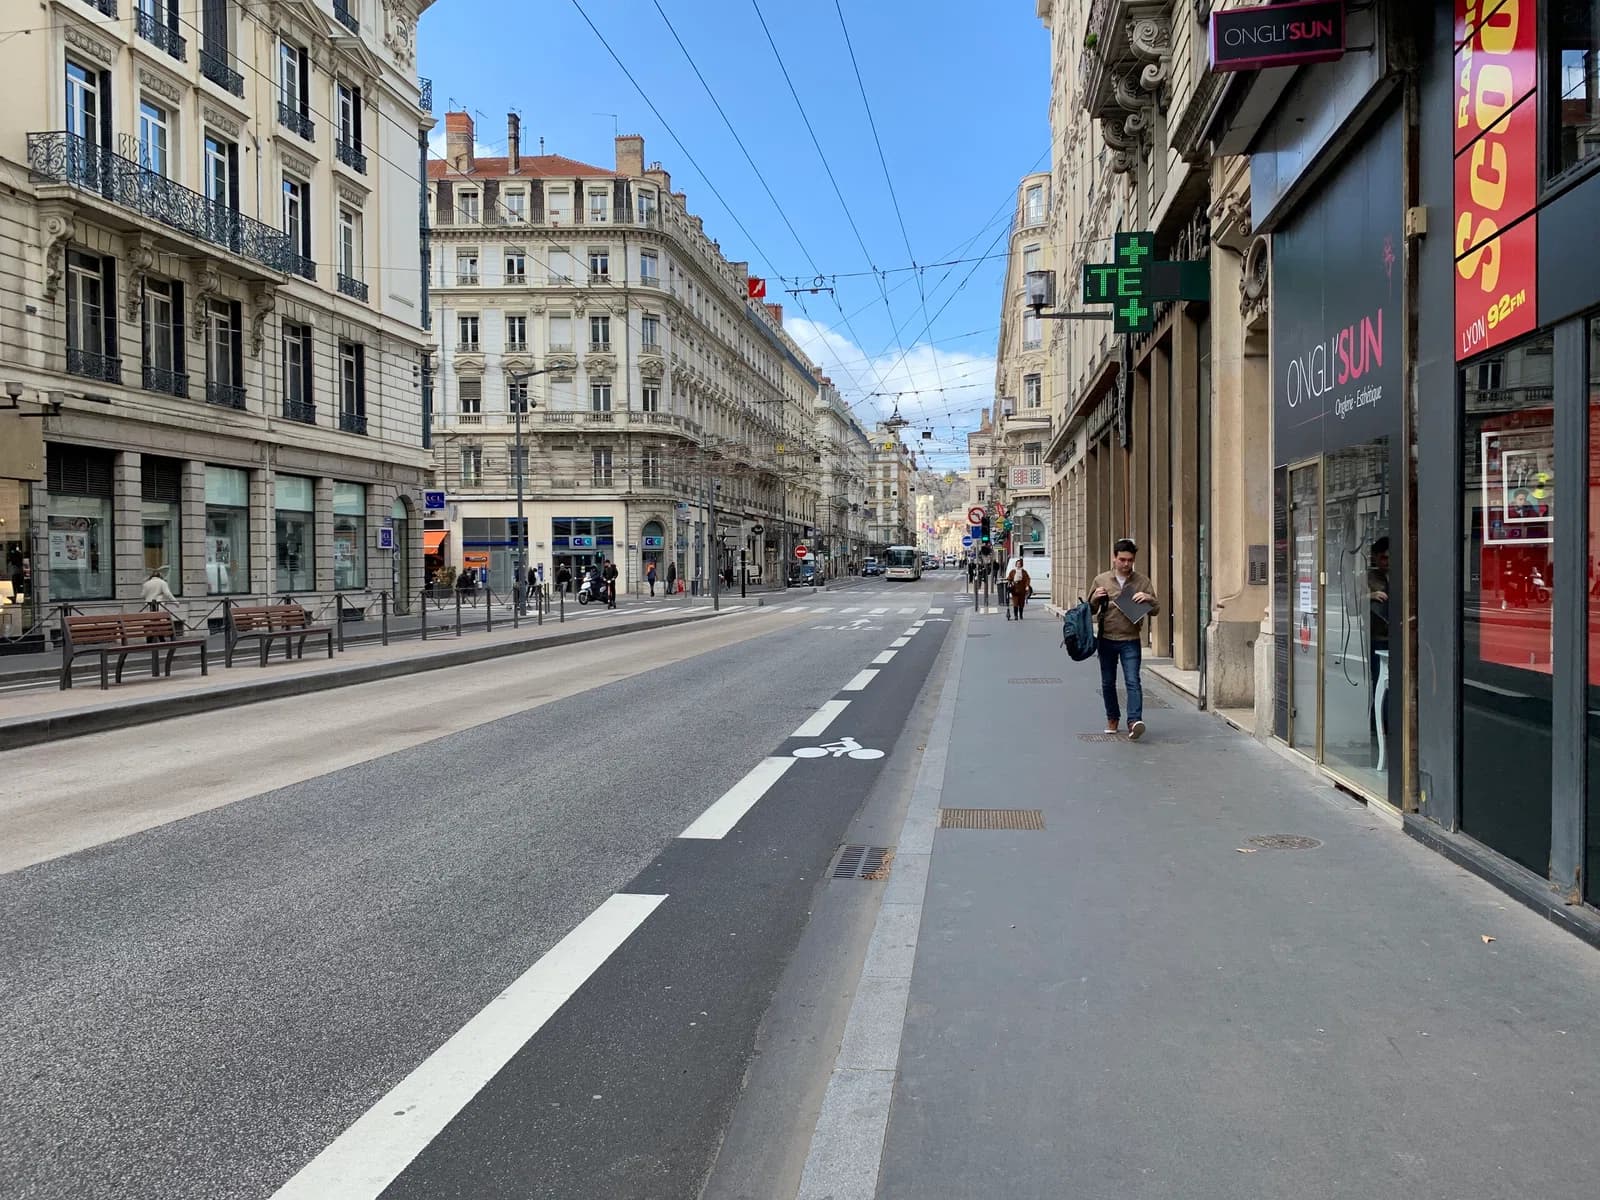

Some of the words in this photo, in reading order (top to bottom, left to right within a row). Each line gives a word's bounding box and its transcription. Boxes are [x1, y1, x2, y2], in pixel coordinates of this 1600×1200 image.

[1224, 19, 1333, 46] ONGLI'SUN
[1086, 267, 1143, 297] TE
[1463, 315, 1486, 353] LYON
[1488, 289, 1526, 330] 92FM
[1287, 307, 1383, 408] ONGLI'SUN
